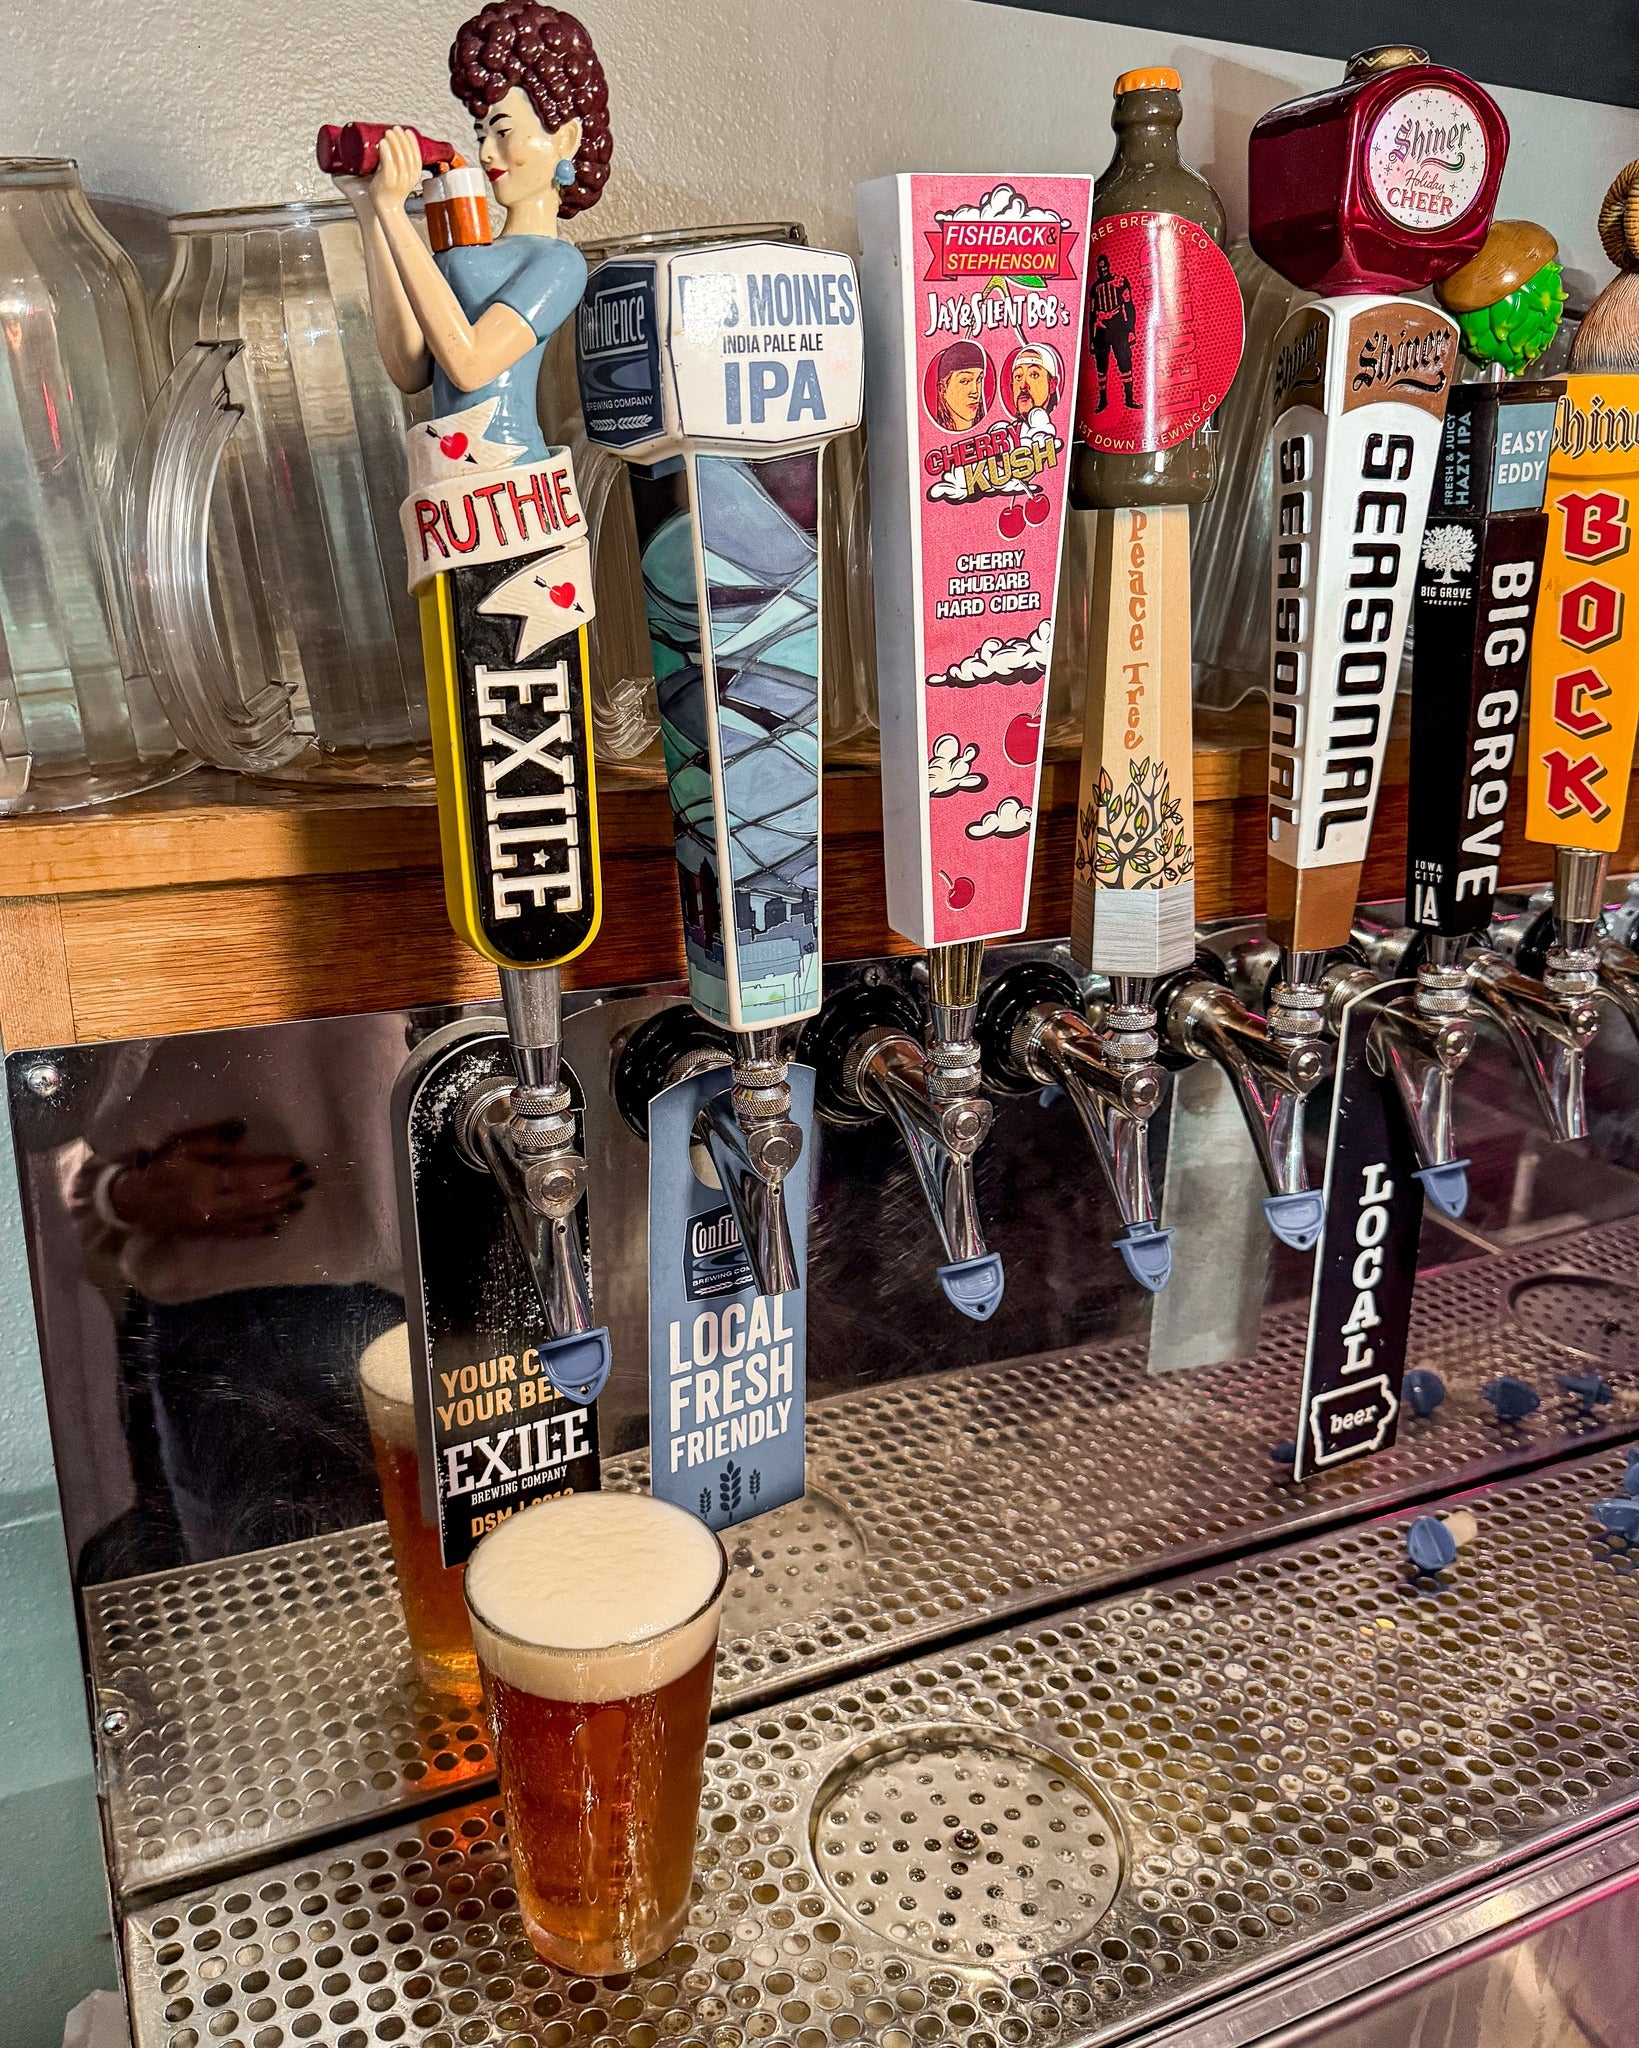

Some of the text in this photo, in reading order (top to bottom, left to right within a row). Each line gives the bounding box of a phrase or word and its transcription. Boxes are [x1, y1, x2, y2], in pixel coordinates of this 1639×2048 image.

[1388, 118, 1472, 164] Shiner
[1387, 187, 1454, 216] CHEER
[1405, 169, 1446, 199] Holiday
[945, 225, 1046, 247] FISHBACK
[1091, 223, 1114, 242] REE
[1120, 215, 1188, 236] BREWNG
[947, 253, 1057, 271] STEPHENSON
[580, 281, 649, 360] Confluence
[747, 273, 856, 328] MOINES
[723, 333, 824, 355] INDIA PALE ALE
[1352, 327, 1451, 392] Shiner
[586, 395, 654, 412] BREWING COMPANY
[724, 359, 827, 425] IPA
[924, 424, 1022, 476] CHERRY
[1094, 435, 1135, 450] DOWN
[1142, 413, 1201, 449] BREWING
[1501, 429, 1548, 455] EASY
[965, 438, 1057, 496] KUSH
[1444, 413, 1456, 505] FRESH & JUICY
[1455, 411, 1472, 505] HAZY IPA
[1497, 460, 1545, 485] EDDY
[415, 468, 581, 561] RUTHIE
[948, 571, 1031, 596] RHUBARB
[956, 550, 1025, 573] CHERRY
[936, 593, 1041, 619] HARD CIDER
[1421, 585, 1472, 599] BIG GROVE
[1122, 508, 1149, 750] Peace Tree
[1269, 433, 1313, 843] SEASONAL
[1313, 432, 1415, 852] SEASONAL
[1540, 488, 1632, 824] BOCK
[1455, 560, 1534, 902] BIG GROVE
[475, 660, 583, 920] EXILE
[1414, 870, 1442, 884] CITY
[1415, 859, 1443, 874] IOWA
[1414, 883, 1440, 927] IA
[692, 1214, 743, 1258] Conflu
[692, 1270, 732, 1287] BREWING
[1340, 1162, 1394, 1375] LOCAL
[669, 1294, 793, 1376] LOCAL
[440, 1355, 517, 1399] YOUR
[669, 1342, 793, 1433] FRESH
[436, 1386, 513, 1432] YOUR
[1330, 1404, 1379, 1434] beer
[443, 1408, 592, 1498] EXILE
[670, 1398, 793, 1474] FRIENDLY
[471, 1481, 518, 1507] BREWING
[521, 1465, 568, 1489] COMPANY
